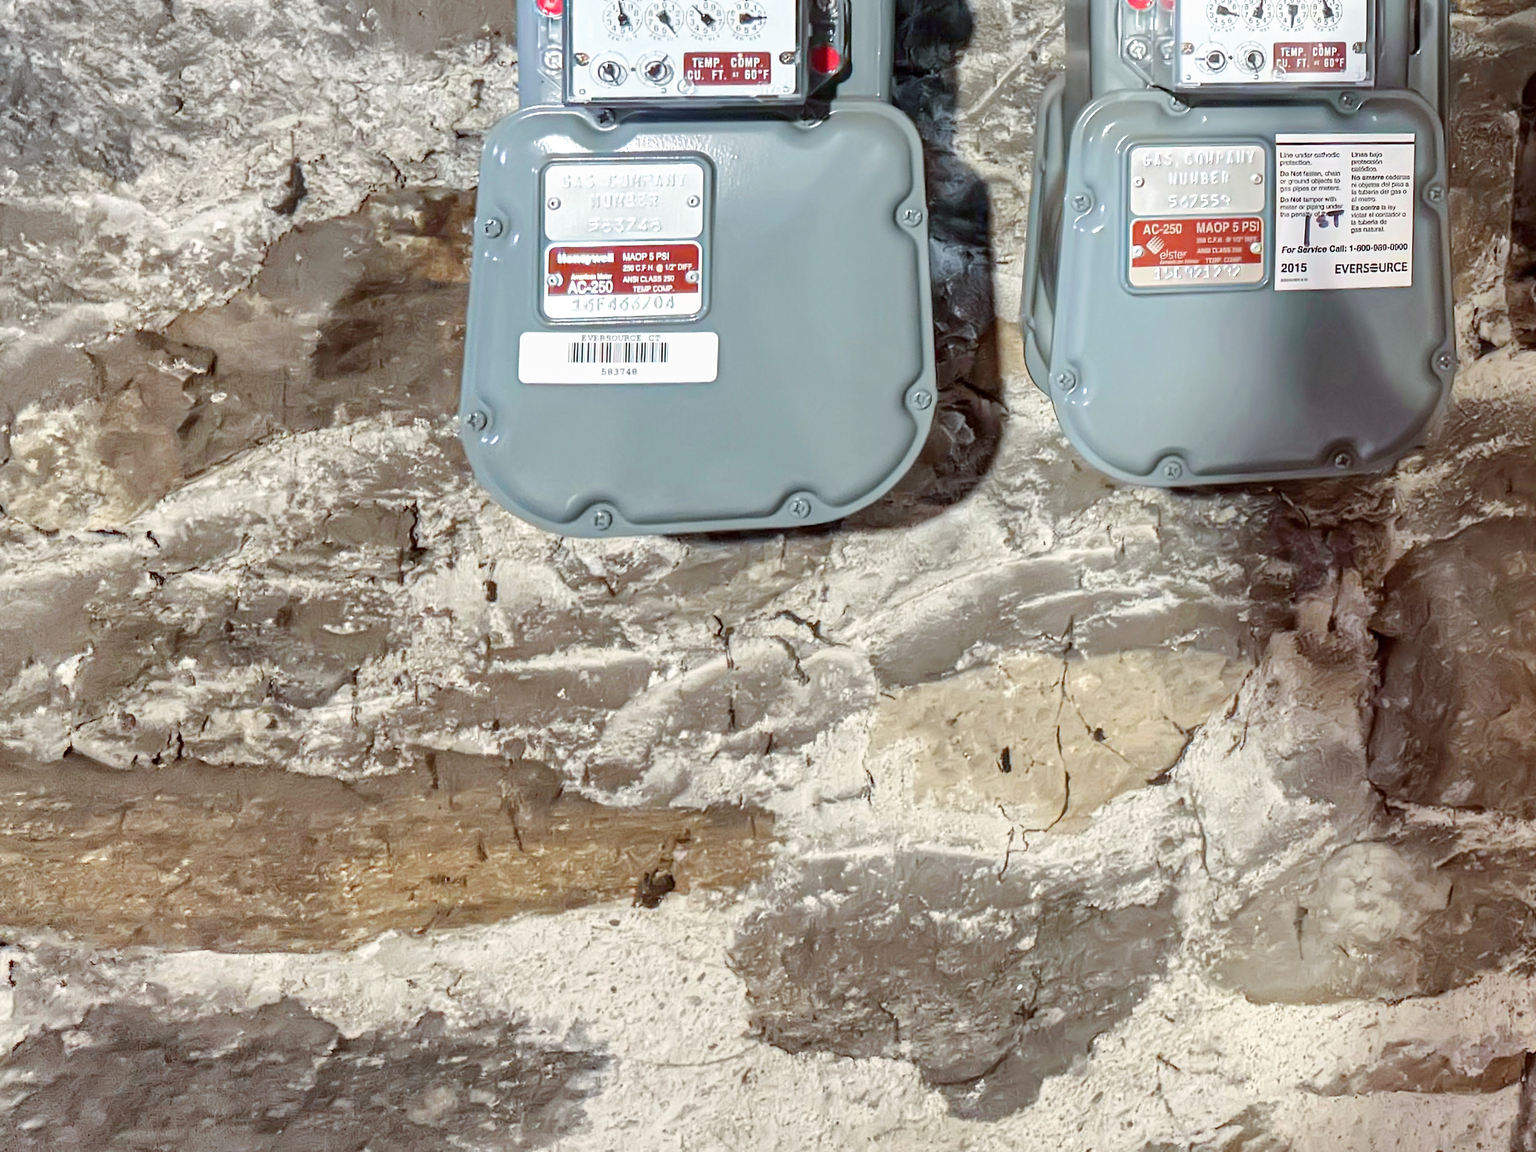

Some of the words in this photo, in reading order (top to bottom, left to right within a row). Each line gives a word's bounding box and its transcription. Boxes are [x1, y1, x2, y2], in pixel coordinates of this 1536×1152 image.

[1280, 46, 1306, 57] TEMP.
[1312, 46, 1340, 57] COMP.
[692, 57, 723, 68] TEMP.
[730, 57, 763, 68] COMP.
[1297, 58, 1309, 68] FT.
[1324, 58, 1345, 68] 60°F
[687, 69, 704, 80] CU.
[711, 69, 727, 80] FT.
[744, 69, 769, 80] 60°F
[1142, 152, 1173, 167] GAS
[1184, 150, 1255, 166] COMPANY
[563, 174, 595, 189] GAS
[608, 172, 687, 188] COMPANY
[1168, 170, 1230, 186] NUMBER
[590, 192, 659, 209] NUMBER
[1143, 223, 1182, 235] AC-250
[1196, 221, 1230, 233] MAOP
[1232, 221, 1239, 232] 5
[1242, 220, 1259, 232] PSI
[1160, 249, 1187, 260] elster
[1281, 246, 1294, 254] For
[1297, 245, 1327, 254] Service
[1329, 244, 1347, 253] Call:
[557, 251, 614, 266] Honeywell
[622, 252, 648, 262] MAOP
[648, 252, 655, 261] 5
[655, 251, 670, 261] PSI
[1281, 262, 1307, 273] 2015
[1335, 261, 1408, 275] EVERSOURCE
[640, 275, 662, 283] CLASS
[567, 280, 614, 295] AC-250
[581, 334, 642, 342] EVERSOURCE
